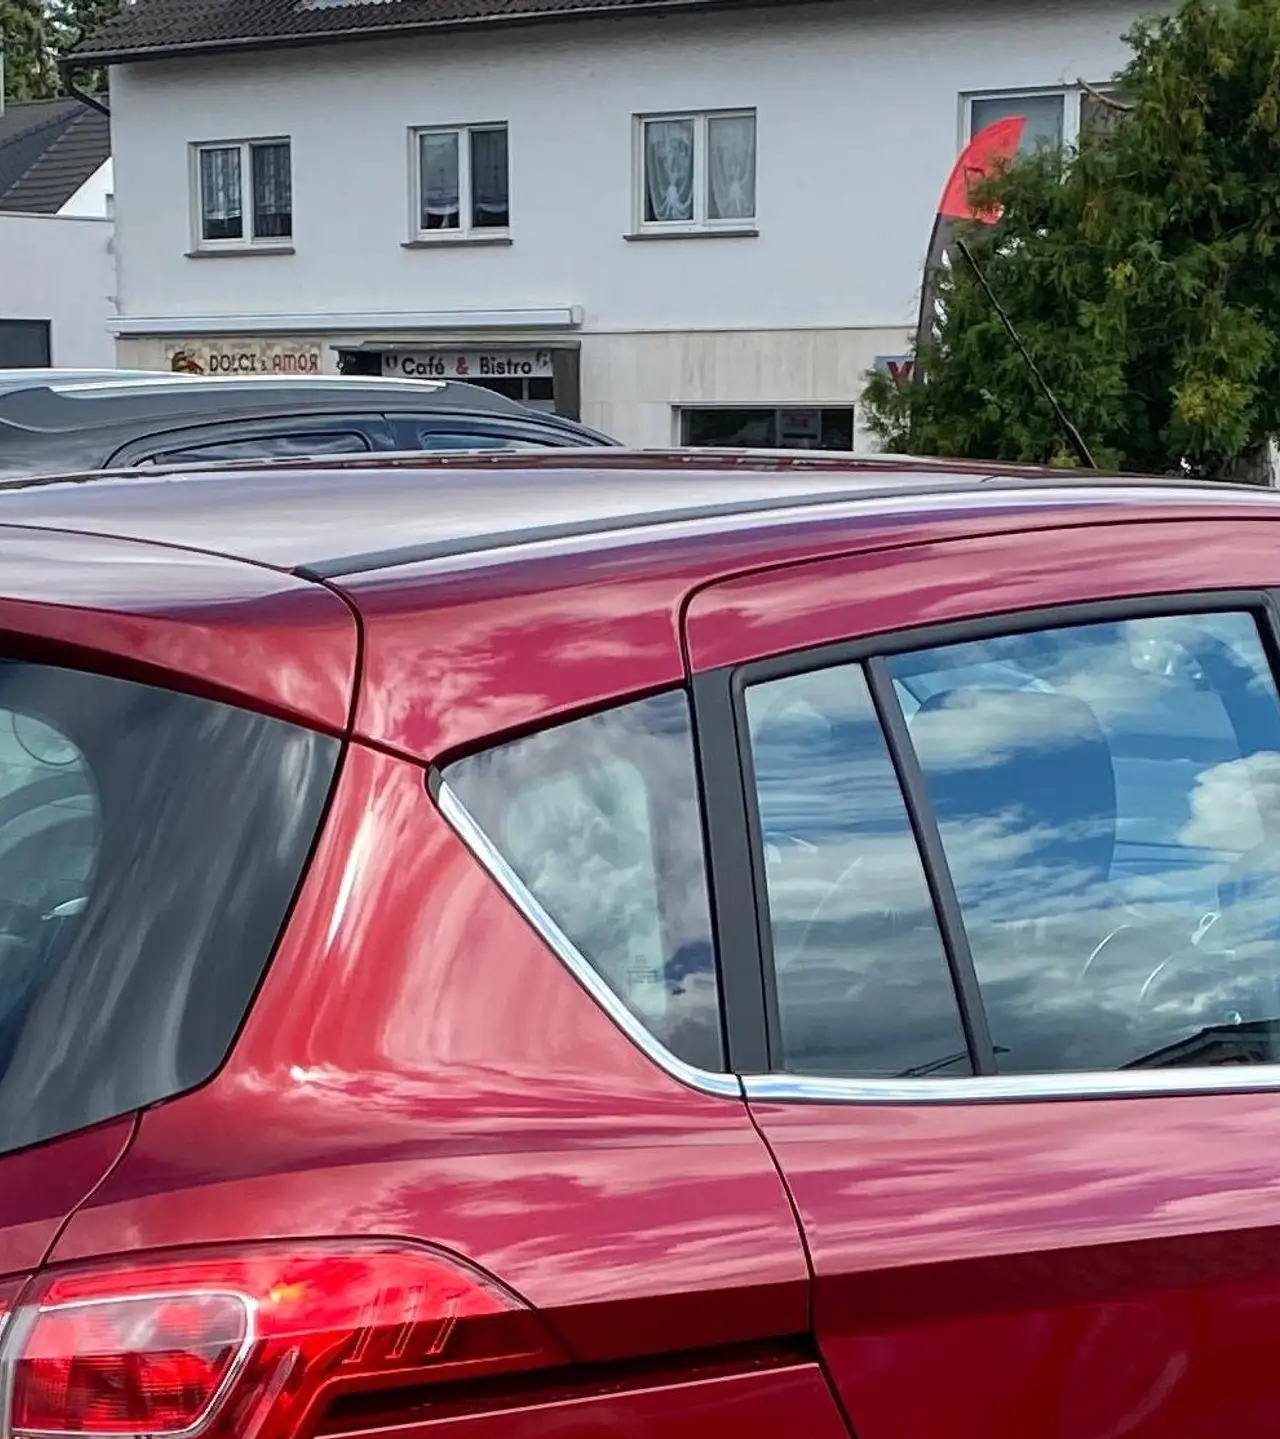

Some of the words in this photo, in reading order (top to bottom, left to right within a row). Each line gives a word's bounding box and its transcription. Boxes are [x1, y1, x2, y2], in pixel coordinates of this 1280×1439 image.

[209, 353, 256, 372] DOLCI
[401, 355, 446, 375] Café
[455, 355, 469, 376] &
[479, 356, 533, 375] Bistro
